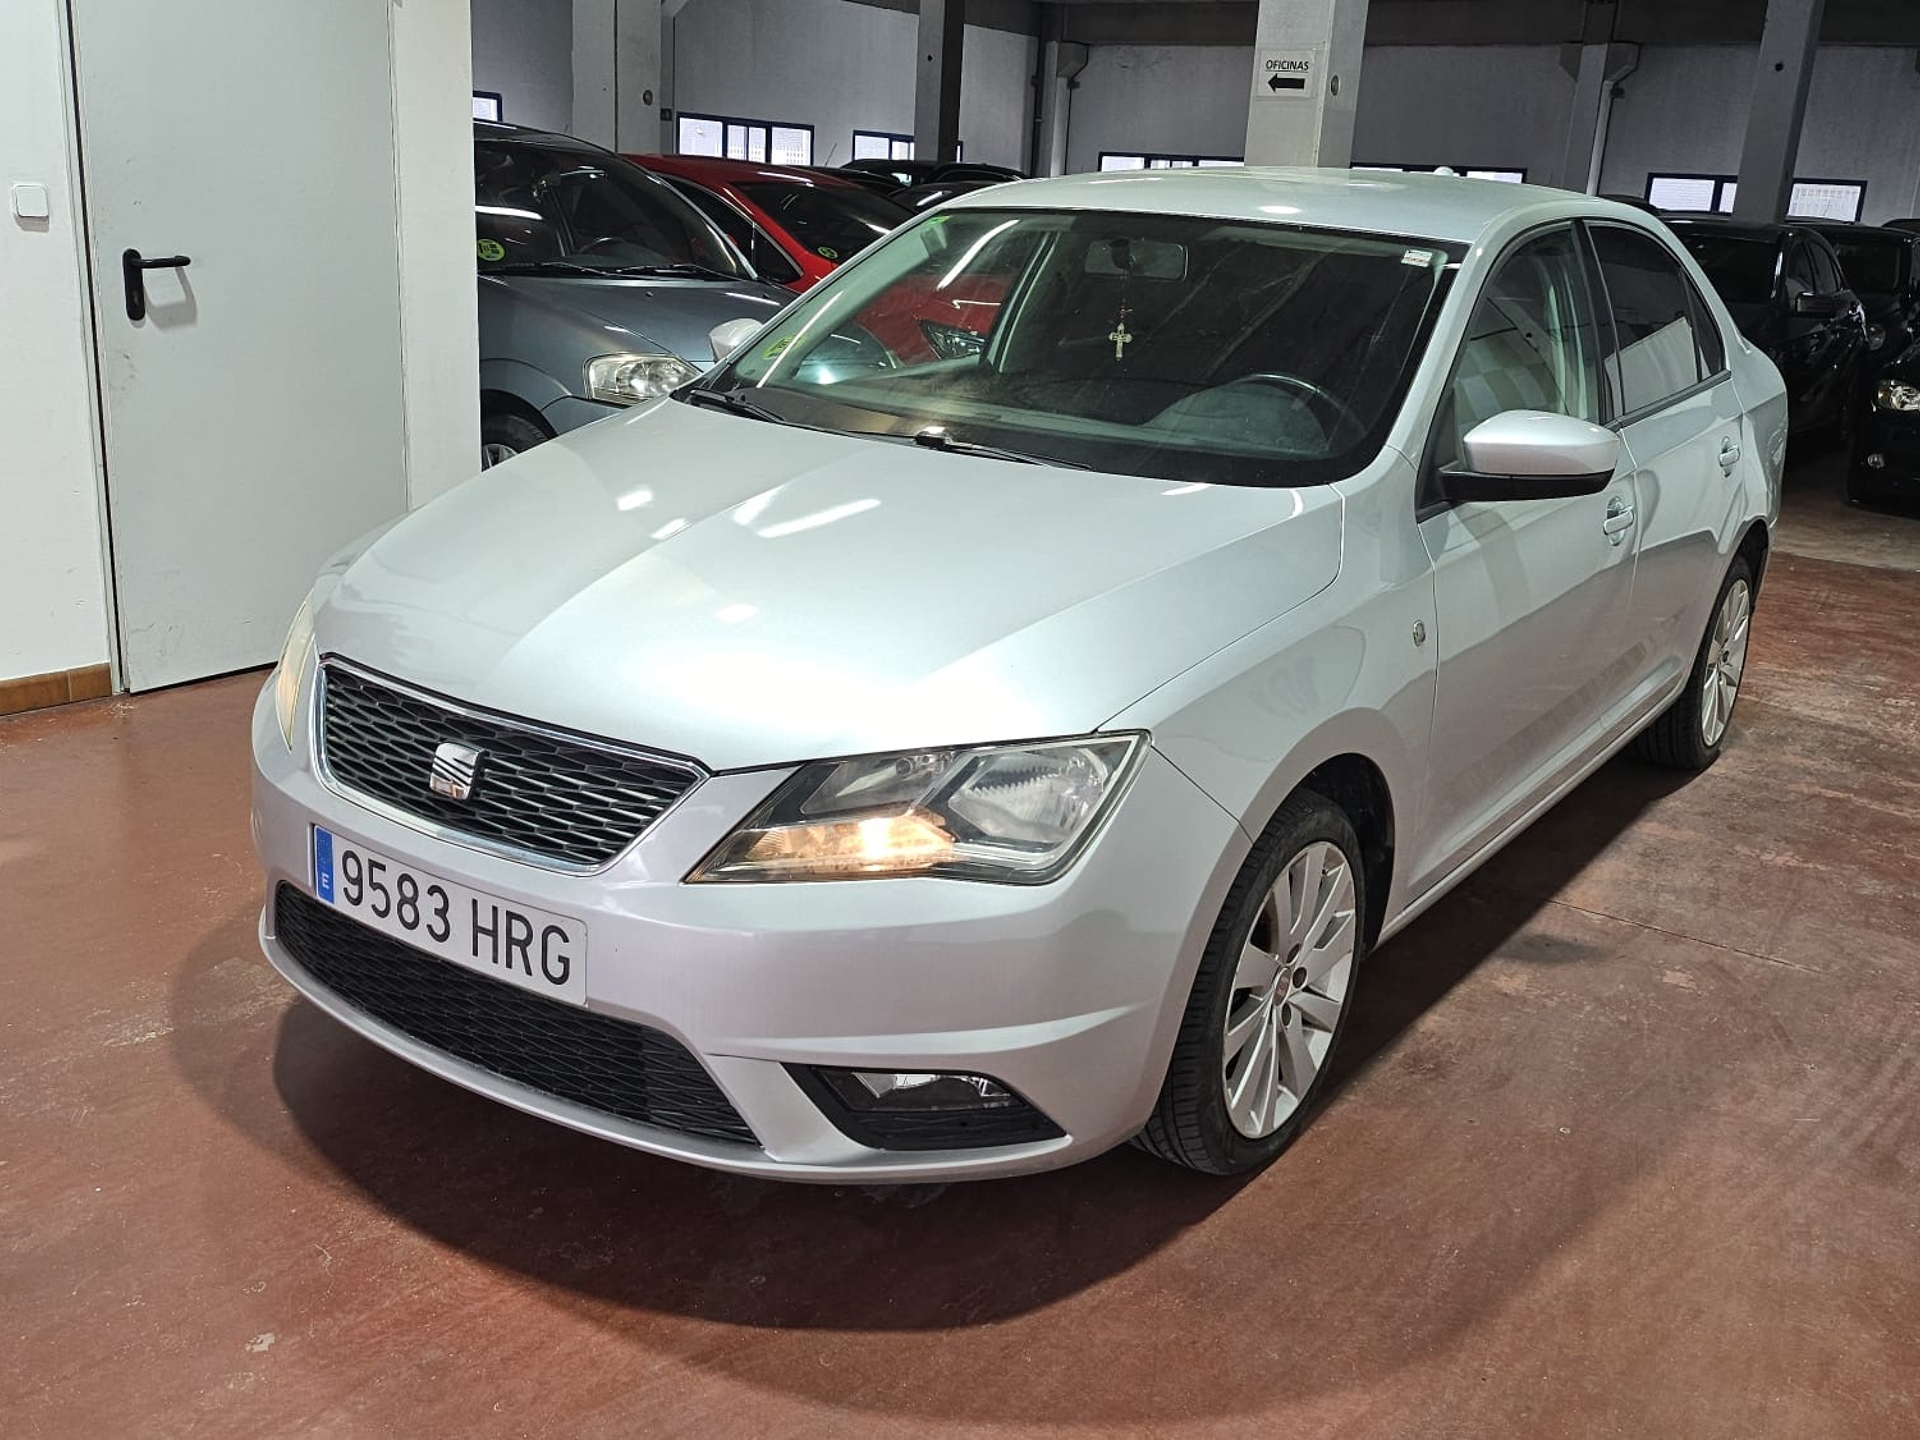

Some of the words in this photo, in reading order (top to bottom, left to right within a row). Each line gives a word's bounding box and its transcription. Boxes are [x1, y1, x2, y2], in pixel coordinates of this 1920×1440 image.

[1266, 60, 1309, 71] OFICINAS
[321, 872, 330, 889] E
[342, 850, 450, 943] 9583
[472, 898, 570, 986] HRG
